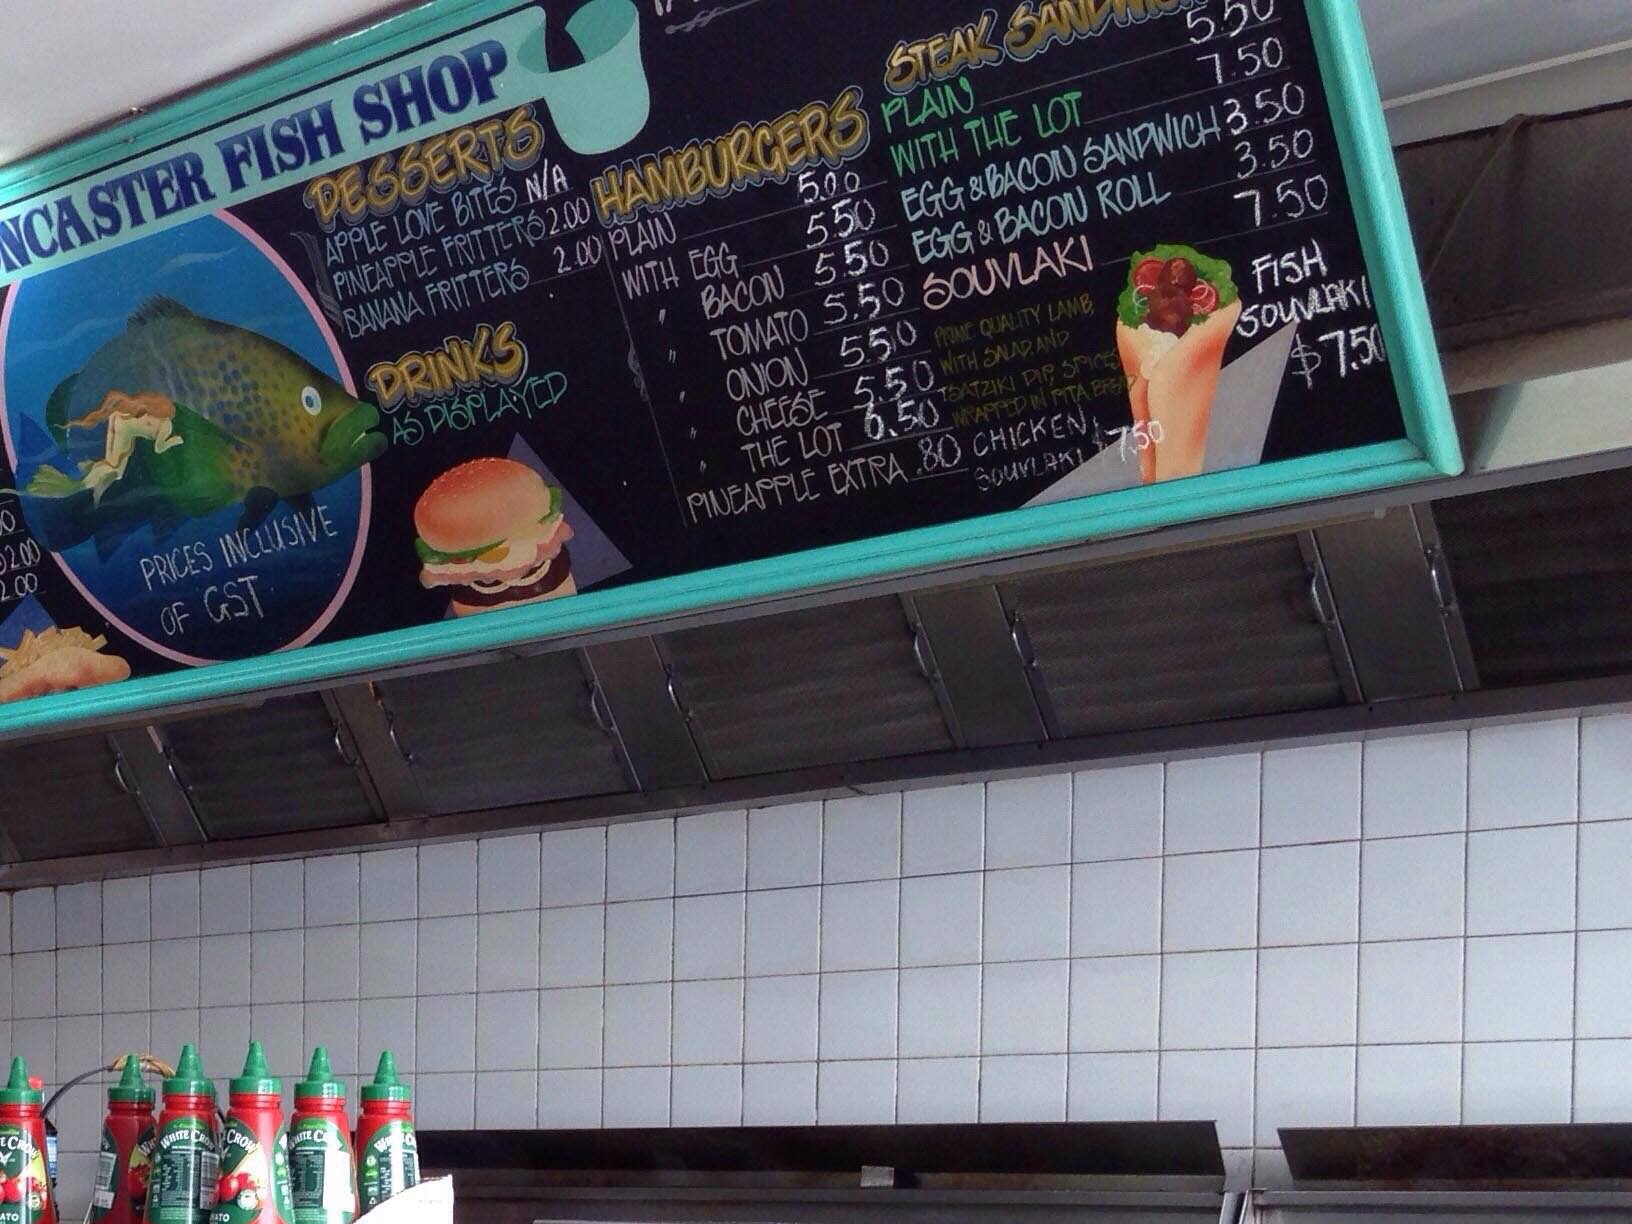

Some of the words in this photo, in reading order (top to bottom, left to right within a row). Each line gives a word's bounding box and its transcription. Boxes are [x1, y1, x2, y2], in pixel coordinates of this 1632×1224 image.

[887, 12, 1003, 92] STEAK
[215, 101, 348, 201] FISH
[355, 37, 510, 147] SHOP
[881, 77, 975, 134] PLAIN
[891, 130, 958, 177] WITH
[965, 112, 1022, 158] THE
[1033, 92, 1083, 140] LOT
[1196, 37, 1283, 85] 7.50
[309, 106, 543, 228] DESSERTS
[592, 88, 868, 222] HAMBURGERS
[901, 173, 965, 222] EGG
[986, 145, 1079, 197] BACON
[1083, 106, 1222, 173] SANDWICH
[1224, 81, 1305, 136] 3.50
[325, 221, 388, 267] APPLE
[394, 201, 444, 245] LOVE
[452, 178, 517, 228] BITES
[525, 159, 569, 203] N/A
[608, 212, 676, 260] PLAIN
[912, 215, 976, 264] EGG
[995, 187, 1088, 248] BACON
[1099, 173, 1172, 219] ROLL
[1234, 128, 1313, 179] 3.50
[333, 246, 436, 300] PINEAPPLE
[442, 210, 545, 268] FRITTERS
[546, 197, 591, 235] 2.00
[622, 257, 679, 299] WITH
[689, 243, 740, 281] EGG
[806, 199, 876, 249] 5.50
[701, 264, 785, 320] BACON
[815, 240, 889, 285] 5.50
[922, 234, 1094, 311] SOUVLAKI
[1232, 174, 1328, 228] 7.50
[1251, 238, 1329, 294] FISH
[343, 291, 425, 339] BANANA
[425, 257, 530, 316] FRITTERS
[553, 234, 602, 274] 2.00
[709, 309, 808, 361] TOMATO
[823, 276, 905, 326] 5.50
[979, 306, 1042, 338] QUALITY
[1235, 275, 1371, 338] SOUVLAKI
[368, 322, 527, 412] DRINKS
[726, 348, 809, 402] ONION
[939, 350, 980, 376] WITH
[392, 412, 424, 446] AS
[424, 371, 567, 432] DISPLAYED
[736, 388, 828, 437] CHEESE
[740, 441, 791, 473] THE
[800, 422, 844, 459] LOT
[973, 403, 1087, 458] CHICKEN
[686, 469, 821, 524] PINEAPPLE
[827, 453, 909, 497] EXTRA
[973, 448, 1083, 493] SOUVLAKI
[139, 541, 213, 591] PRICES
[220, 505, 338, 568] INCLUSIVE
[160, 601, 189, 636] OF
[203, 575, 265, 623] GST
[160, 1131, 190, 1149] WHITE
